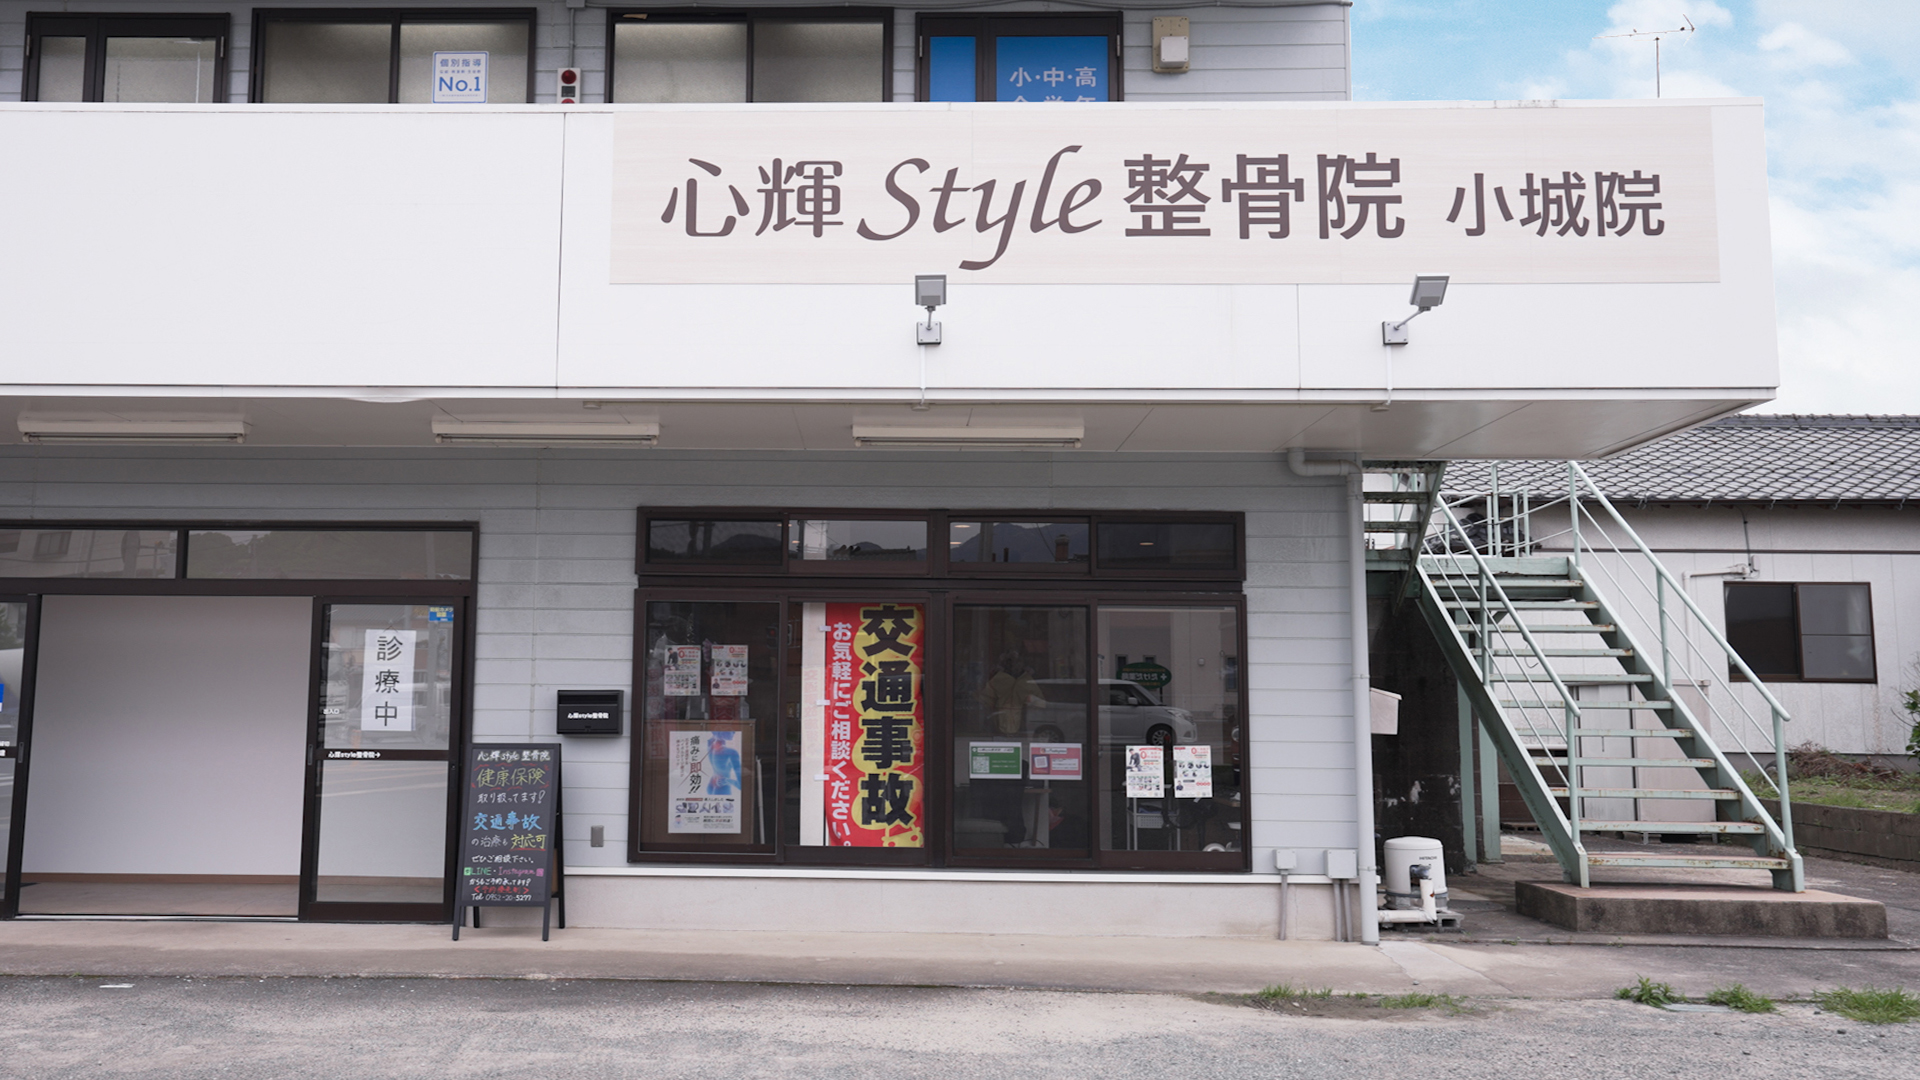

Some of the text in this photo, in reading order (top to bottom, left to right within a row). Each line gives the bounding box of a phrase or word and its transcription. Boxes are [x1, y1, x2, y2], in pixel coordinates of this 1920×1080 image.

[440, 58, 482, 67] 個別指導
[439, 76, 481, 92] No.1
[660, 145, 1665, 271] 心輝 Style 整骨院 小城院
[375, 635, 403, 727] 診療中
[861, 604, 916, 828] 交通事故
[831, 622, 853, 846] お気軽にご相談ください。
[476, 767, 546, 788] 健康保険
[473, 811, 542, 830] 交通事故
[510, 833, 547, 849] 対応可
